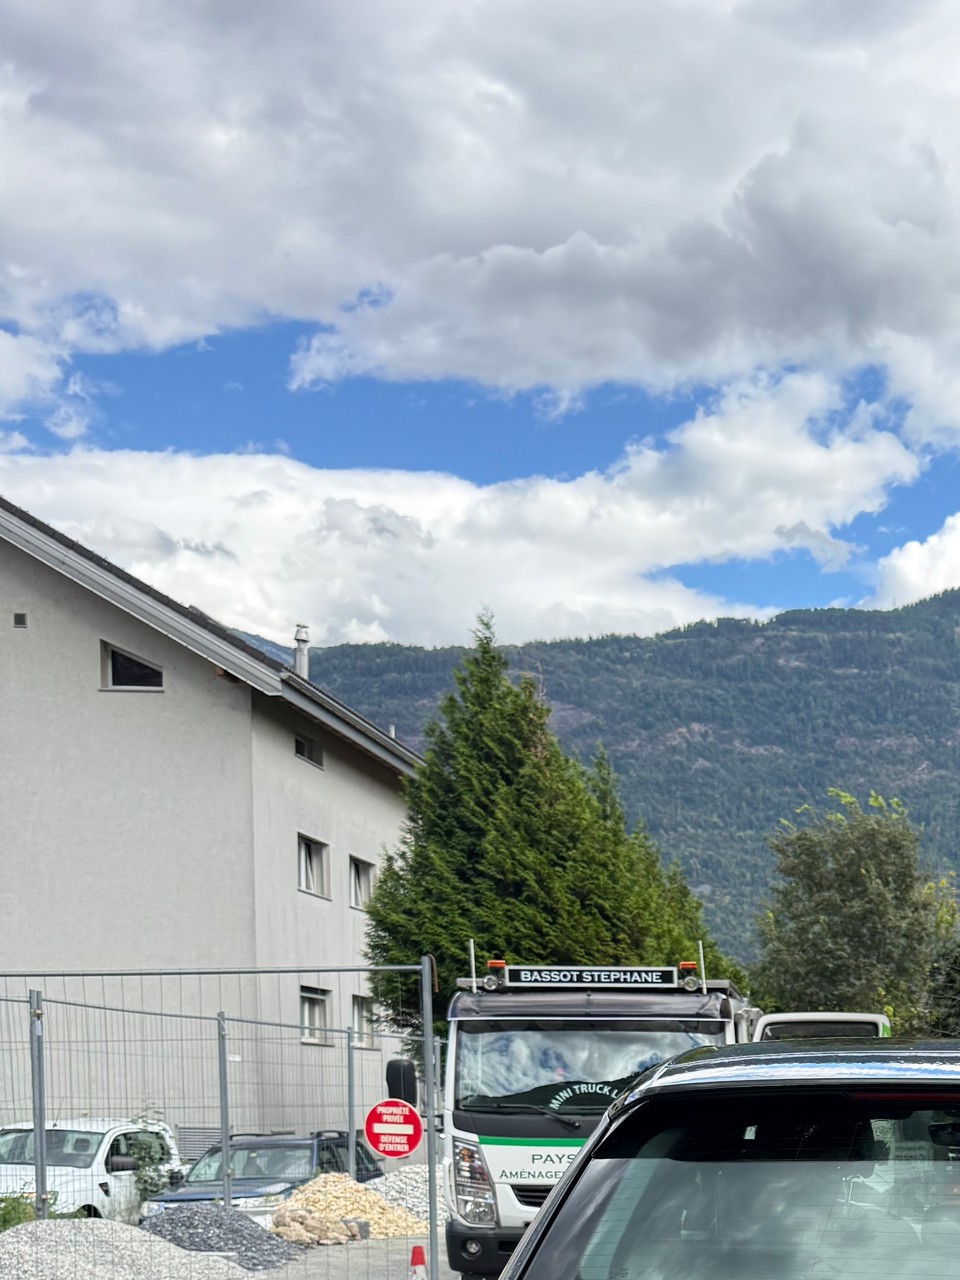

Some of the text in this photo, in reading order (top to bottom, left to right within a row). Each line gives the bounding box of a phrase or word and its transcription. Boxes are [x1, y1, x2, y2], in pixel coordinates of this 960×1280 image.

[520, 970, 662, 983] BASSOT STEPHANE
[549, 1088, 574, 1110] MINI
[572, 1083, 612, 1096] TRUCK
[381, 1114, 405, 1123] PRIVÉE
[380, 1134, 408, 1143] DÉFENSE
[378, 1143, 410, 1152] D'ENTRER
[499, 1168, 565, 1180] AMÉNAGE
